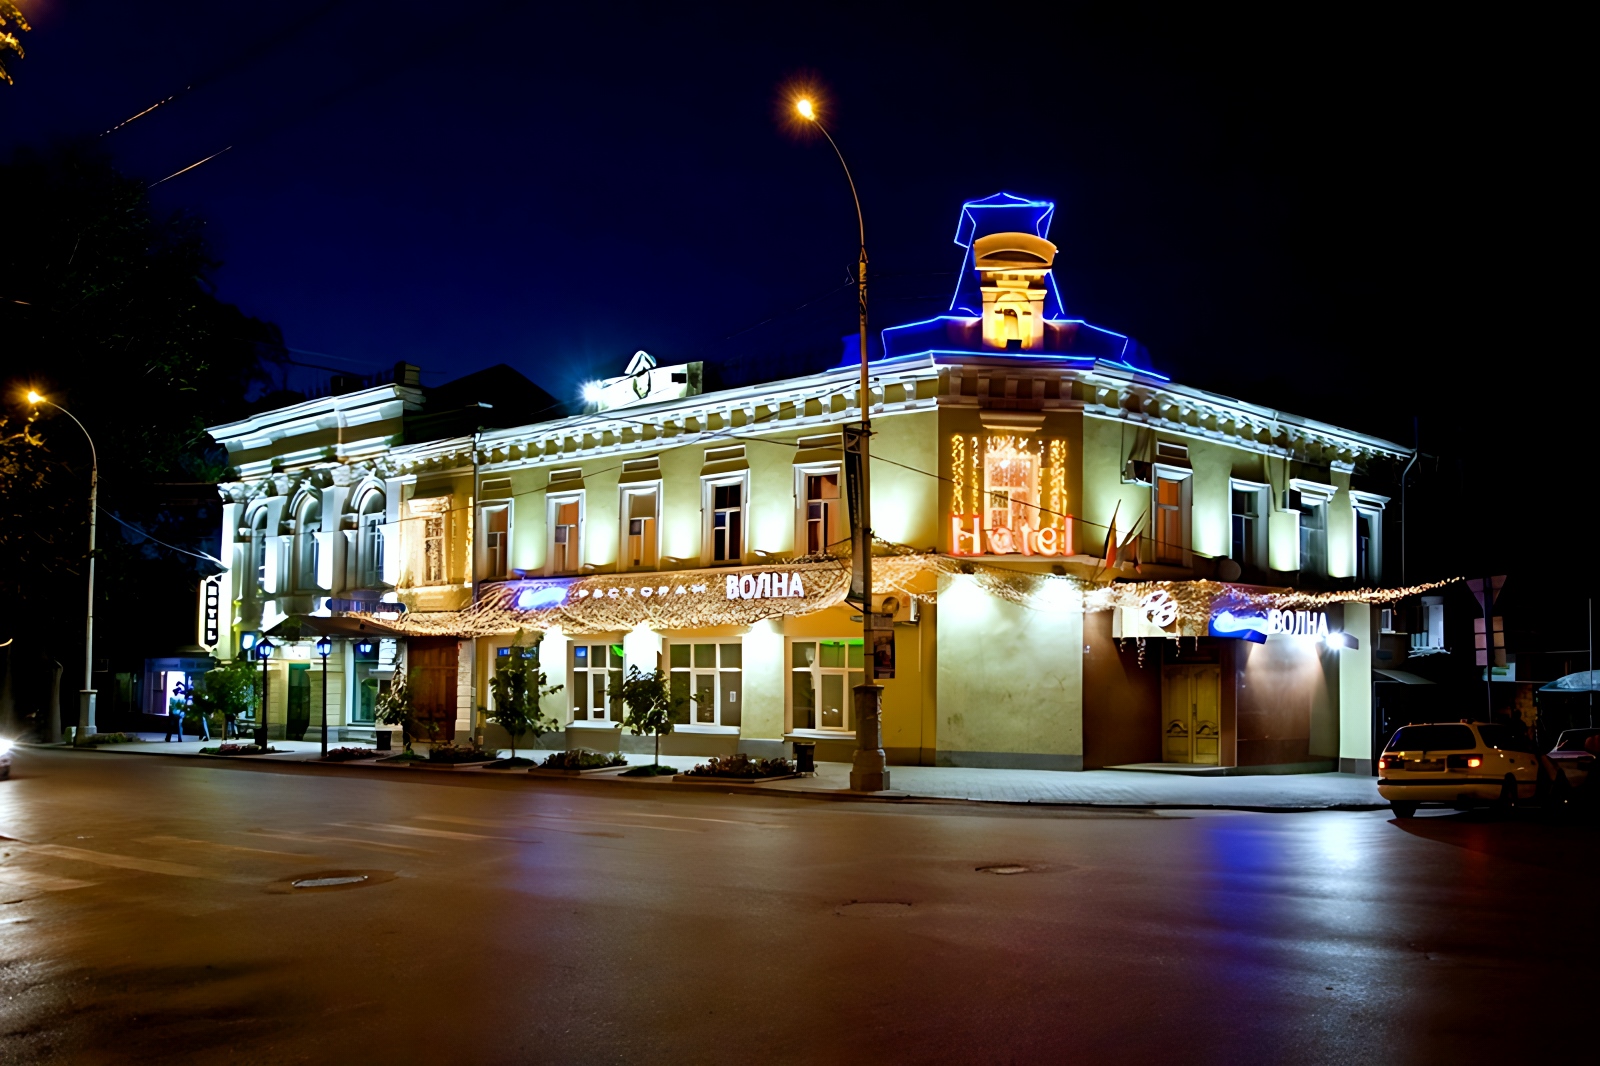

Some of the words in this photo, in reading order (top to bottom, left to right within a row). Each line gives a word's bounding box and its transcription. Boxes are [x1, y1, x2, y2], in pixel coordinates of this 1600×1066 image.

[951, 515, 1074, 556] Hotel
[726, 571, 804, 600] ВОЛНА
[1267, 608, 1331, 636] ВОЛНА
